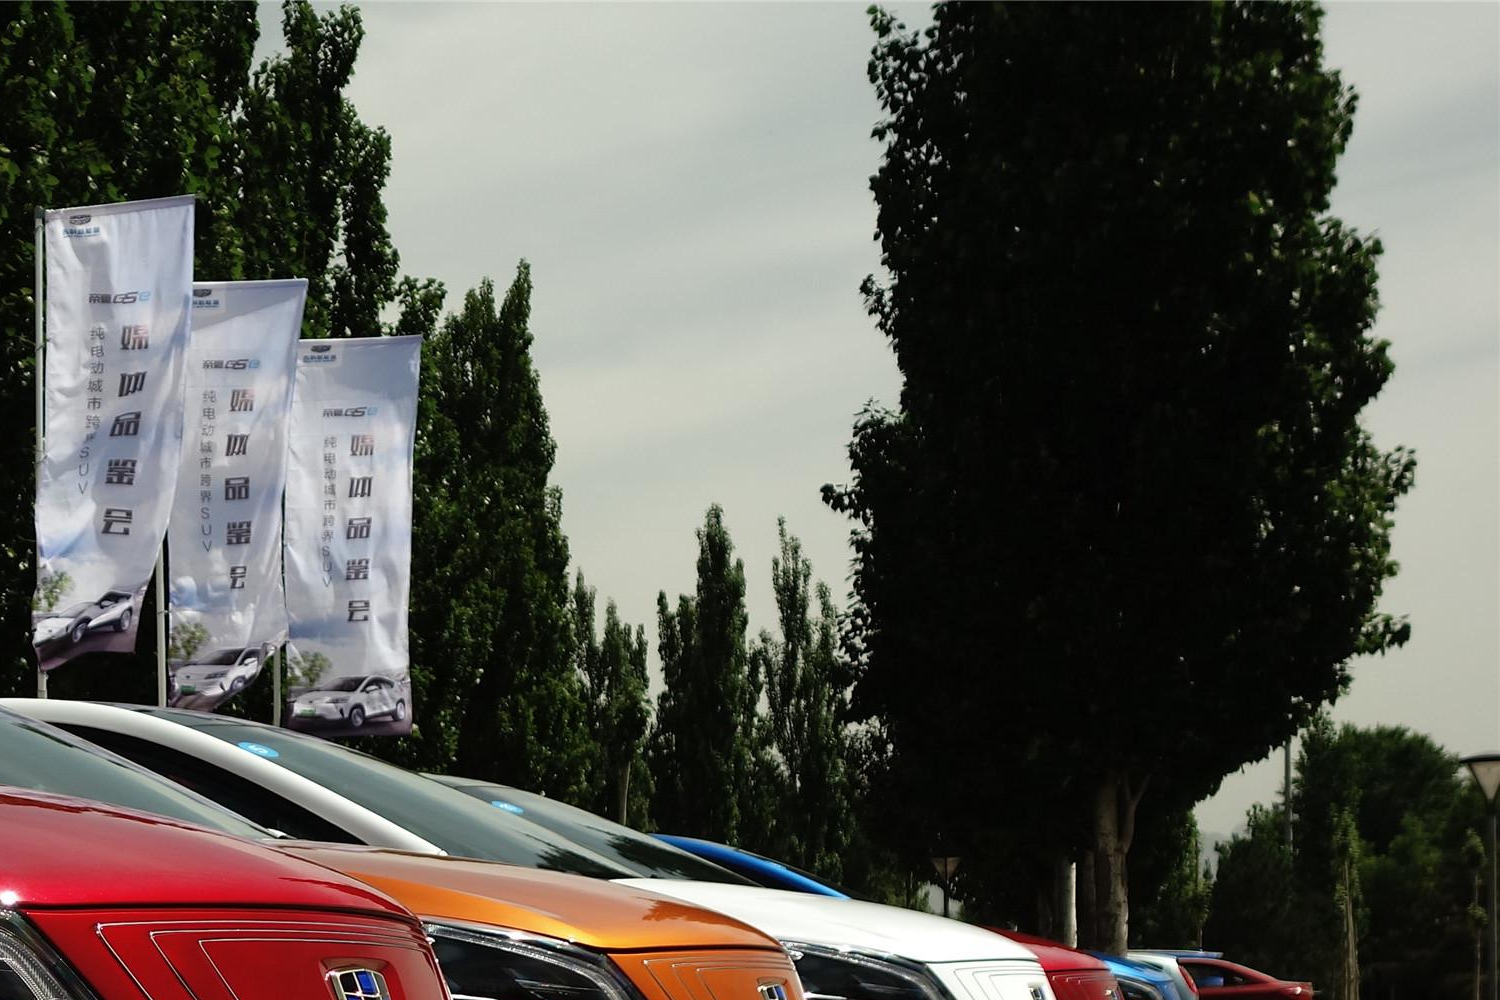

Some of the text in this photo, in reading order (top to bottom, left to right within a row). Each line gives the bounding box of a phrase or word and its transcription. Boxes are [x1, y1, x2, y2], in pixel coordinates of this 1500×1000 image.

[101, 324, 149, 536] 媒体品鉴会
[225, 388, 255, 590] 媒体品鉴会
[346, 434, 375, 622] 媒体品鉴会
